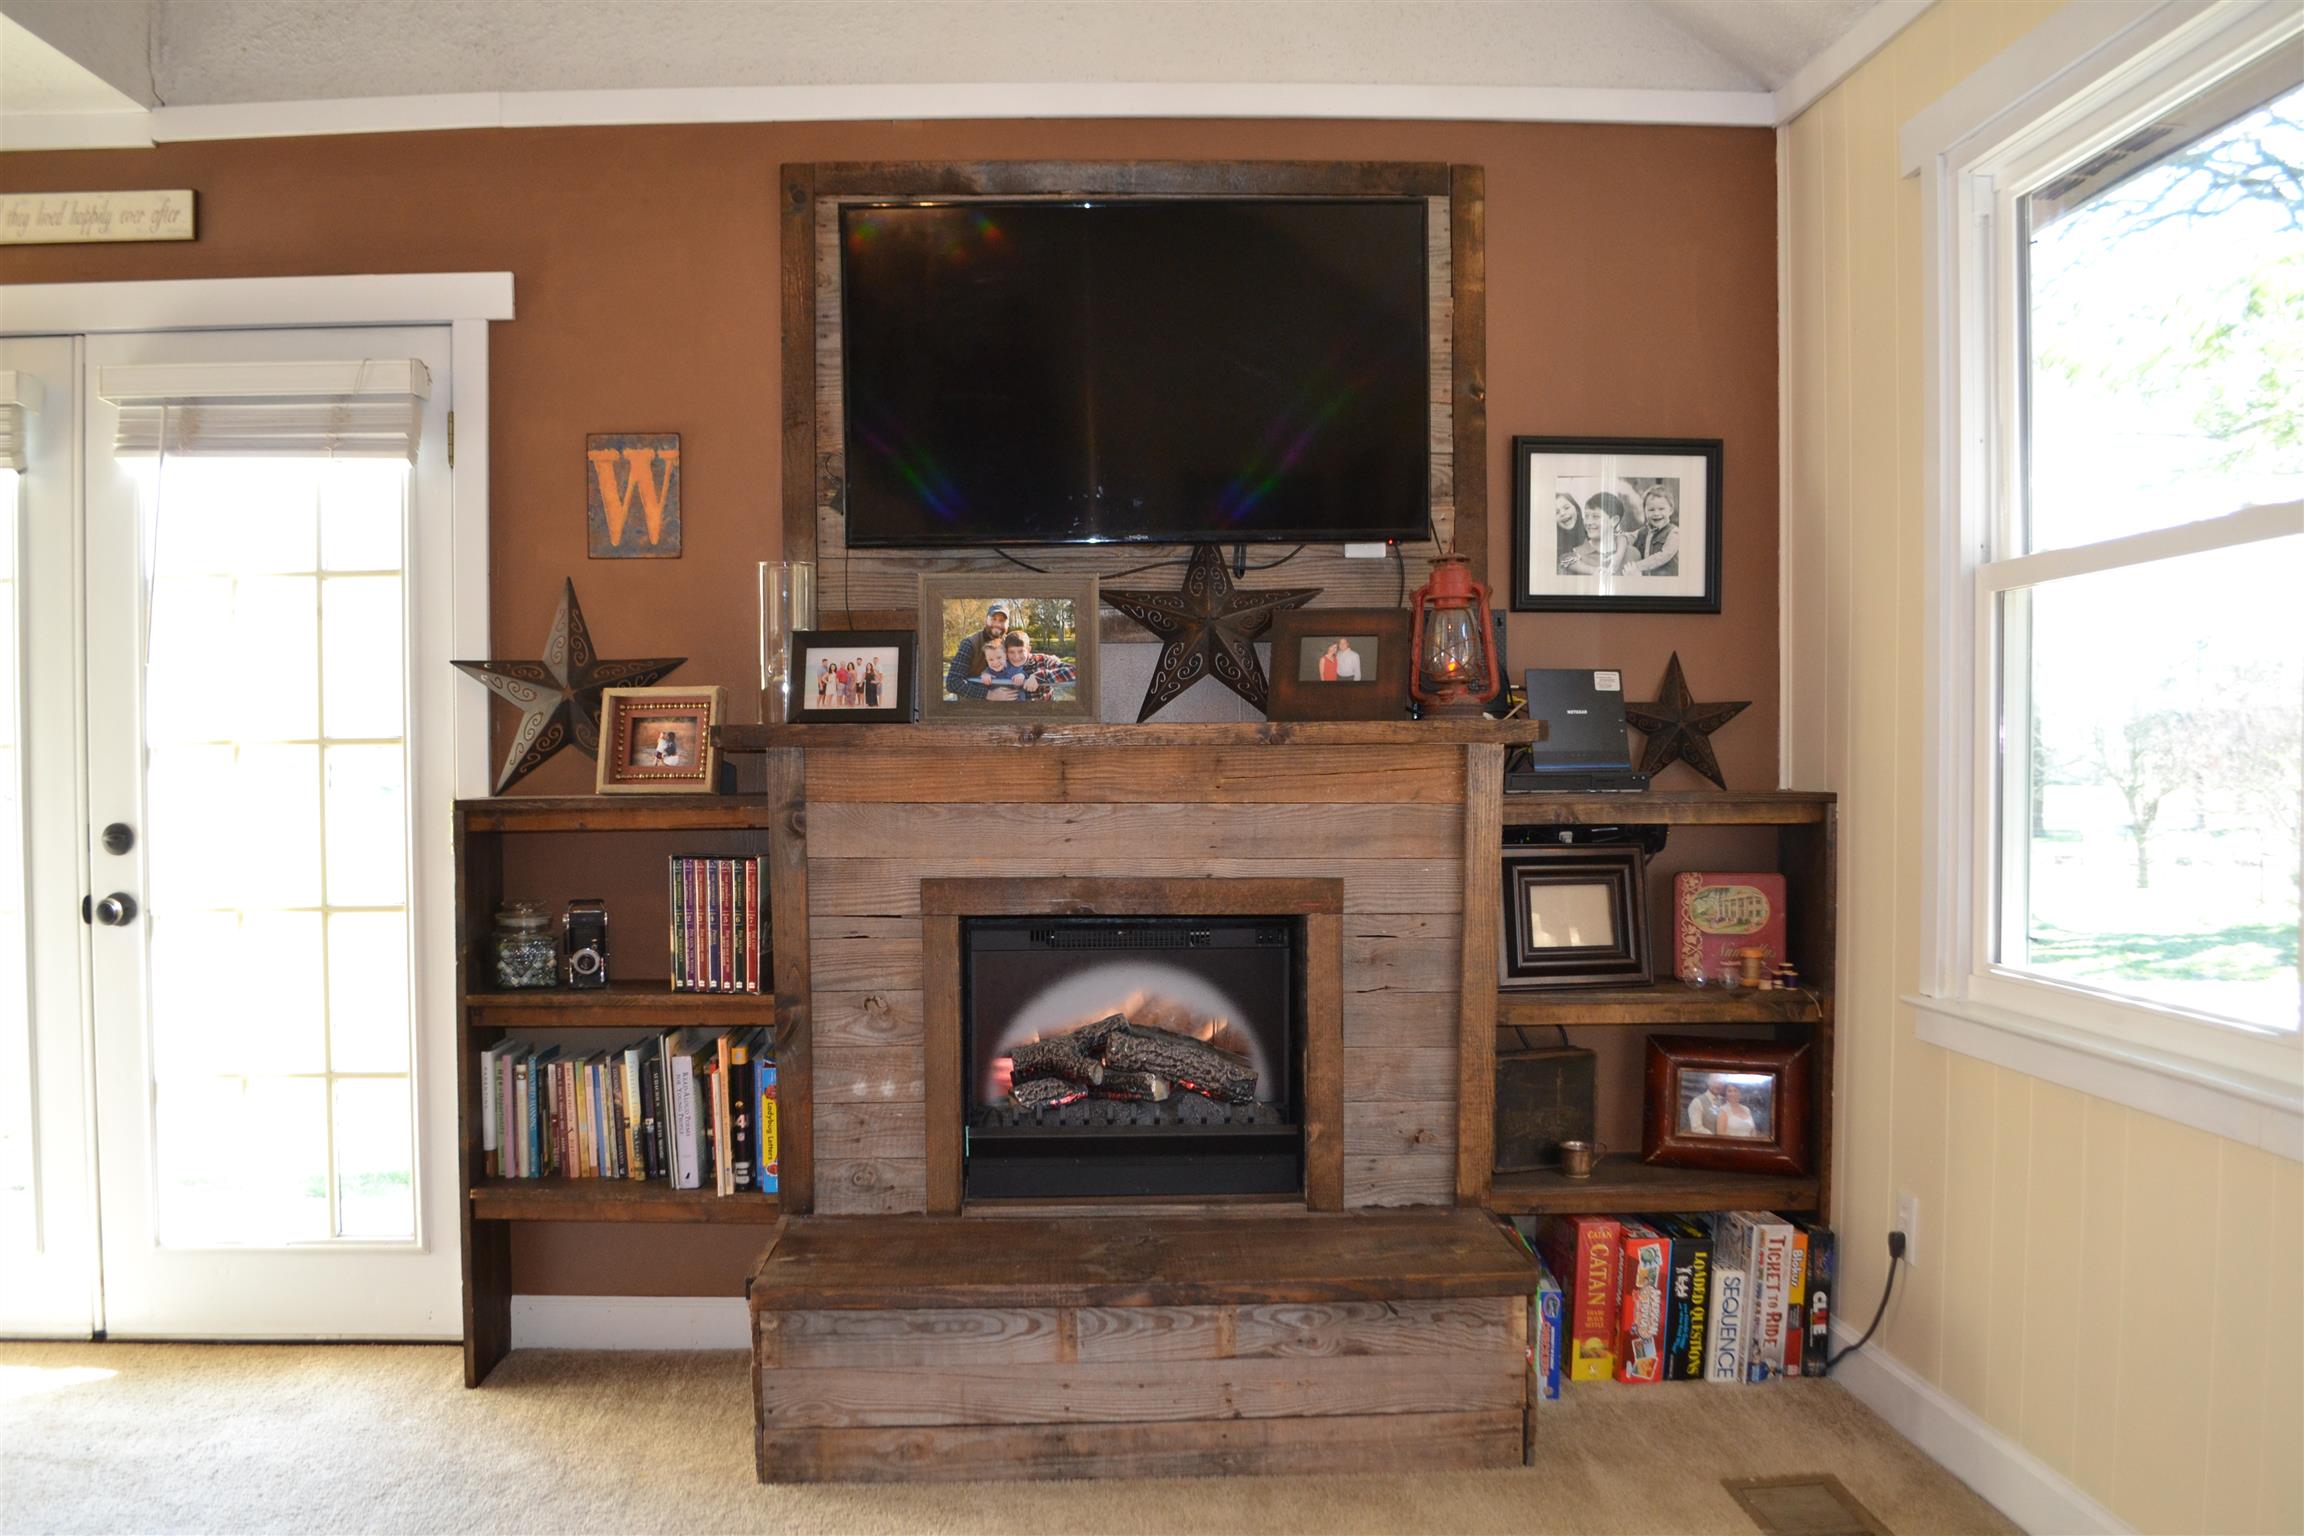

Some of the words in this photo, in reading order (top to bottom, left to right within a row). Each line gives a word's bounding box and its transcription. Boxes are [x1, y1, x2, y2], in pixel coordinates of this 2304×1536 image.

[119, 208, 146, 225] ever
[150, 197, 182, 234] after
[587, 448, 680, 546] W
[764, 1101, 776, 1134] Ladybug
[767, 1136, 776, 1161] Letters
[1587, 1243, 1610, 1306] CATAN
[1691, 1251, 1708, 1305] LOADED
[1766, 1235, 1787, 1292] TICKET
[1767, 1295, 1779, 1309] TO
[1812, 1290, 1828, 1335] CLUE
[1686, 1306, 1705, 1376] QUESTIONS
[1716, 1276, 1741, 1378] SEQUENCE
[1763, 1312, 1783, 1348] RIDE
